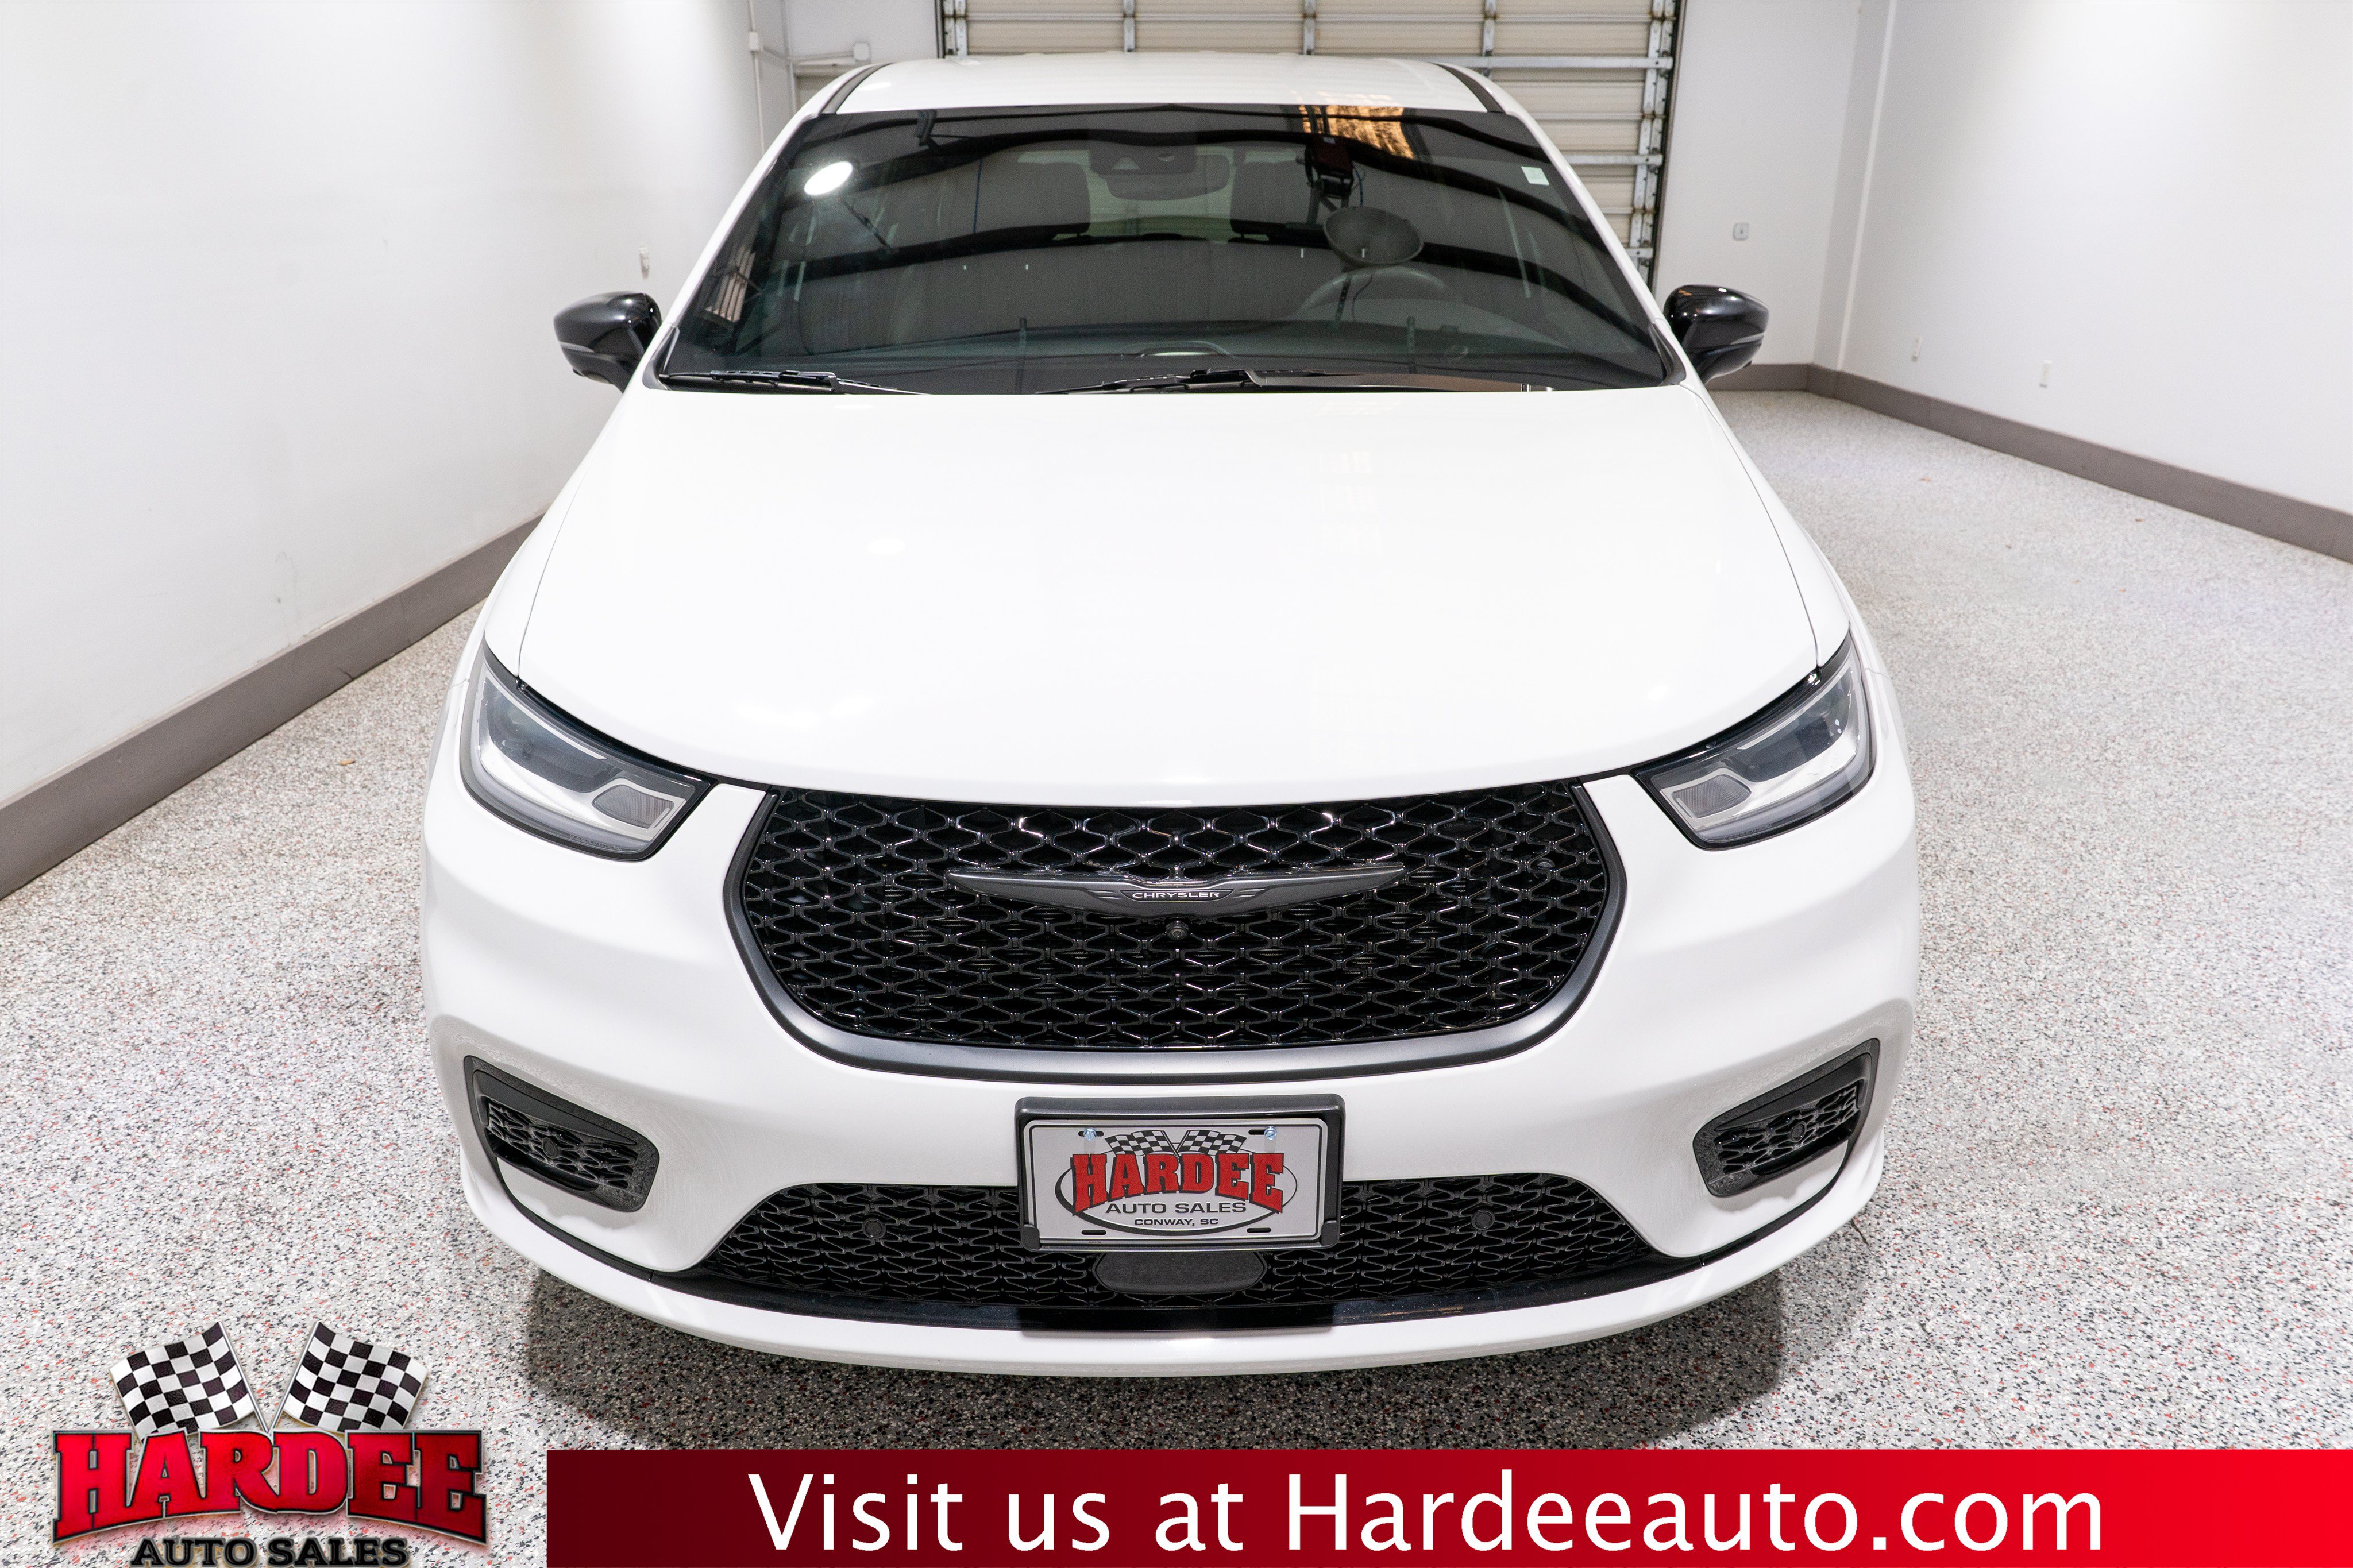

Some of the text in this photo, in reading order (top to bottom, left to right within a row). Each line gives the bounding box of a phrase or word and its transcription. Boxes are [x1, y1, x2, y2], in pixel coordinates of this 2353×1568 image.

[1071, 1153, 1284, 1214] HARDEE
[1105, 1202, 1247, 1214] AUTO SALES
[1134, 1218, 1195, 1226] CONWAY,
